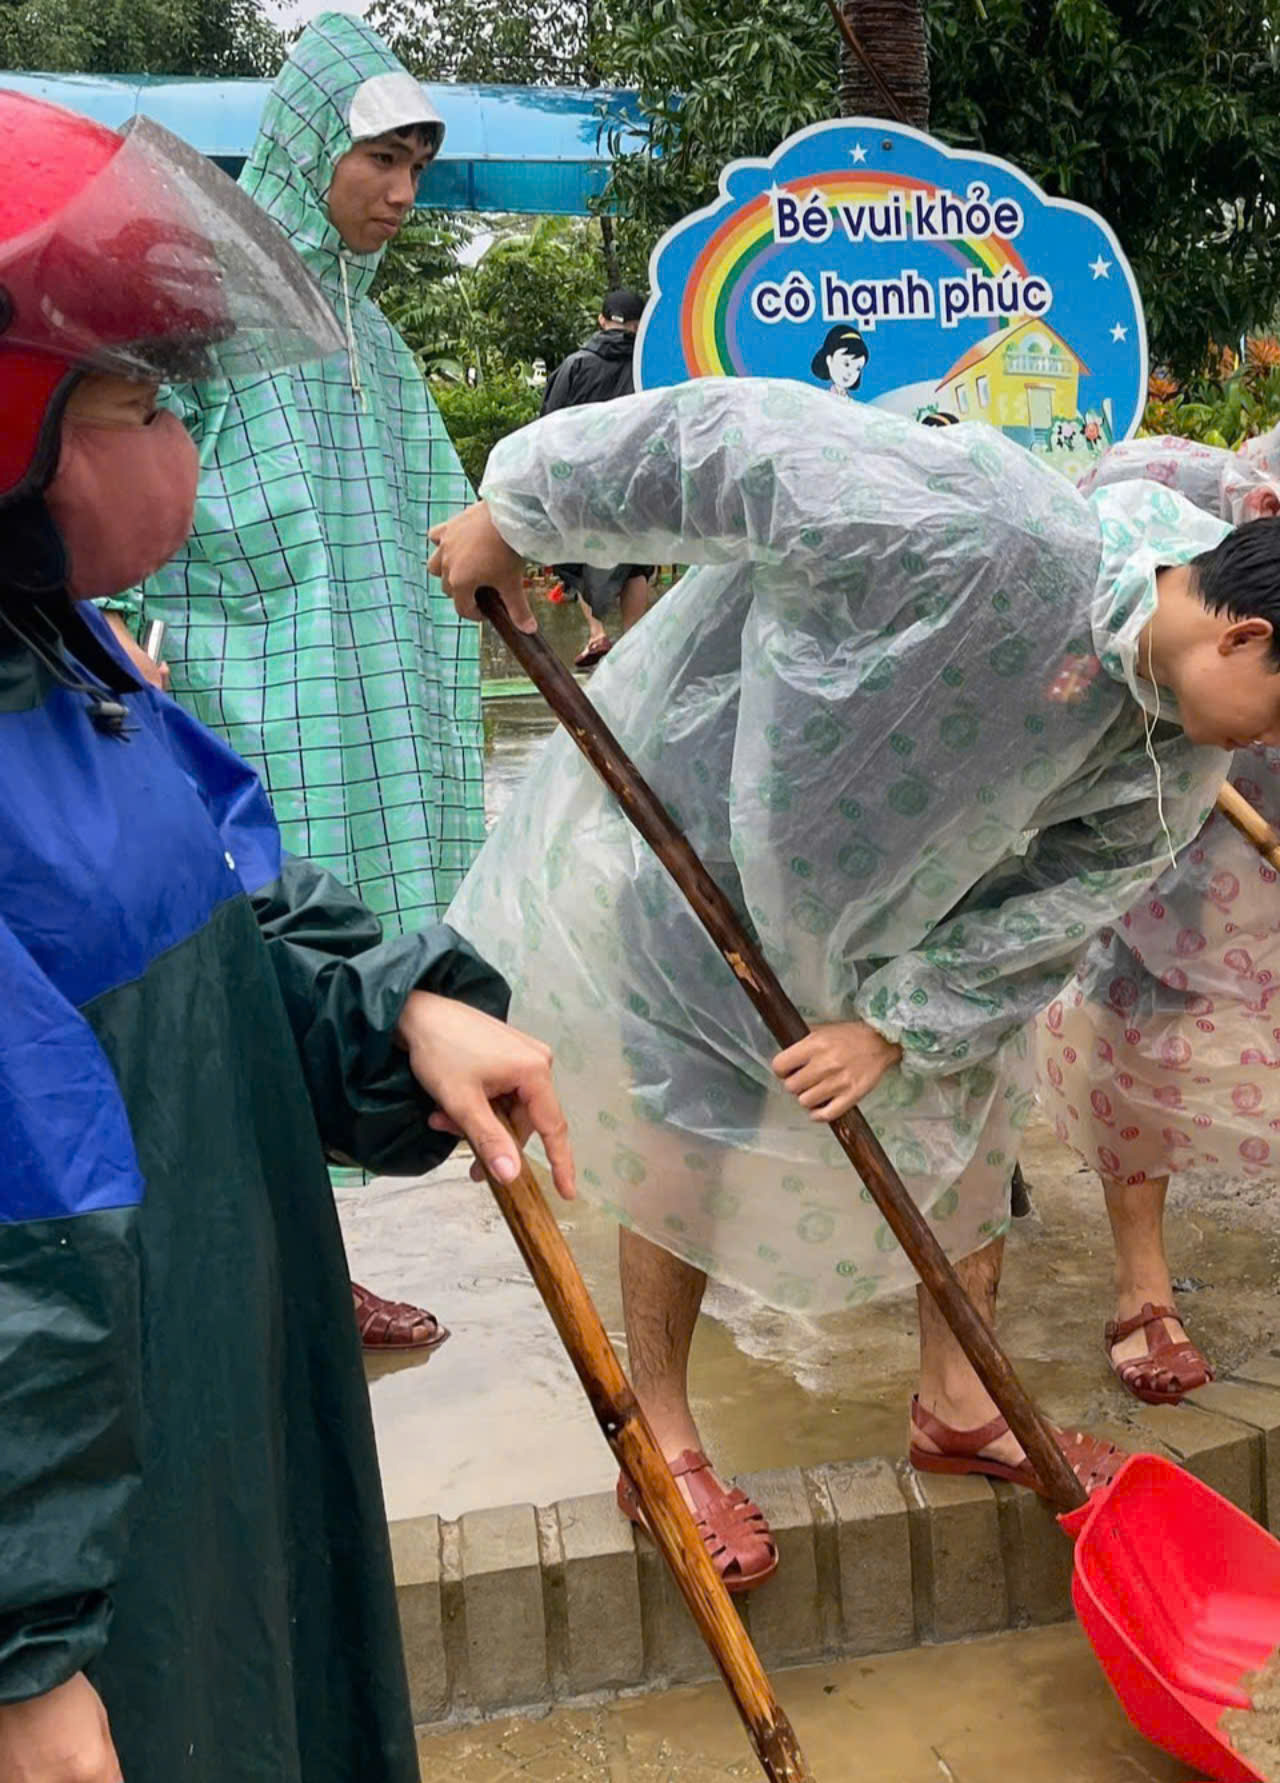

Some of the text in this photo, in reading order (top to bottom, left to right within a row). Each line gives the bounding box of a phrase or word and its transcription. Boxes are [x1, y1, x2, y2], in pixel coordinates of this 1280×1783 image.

[777, 186, 1018, 238] Bé vui khỏe
[756, 270, 1046, 327] cô hạnh phúc
